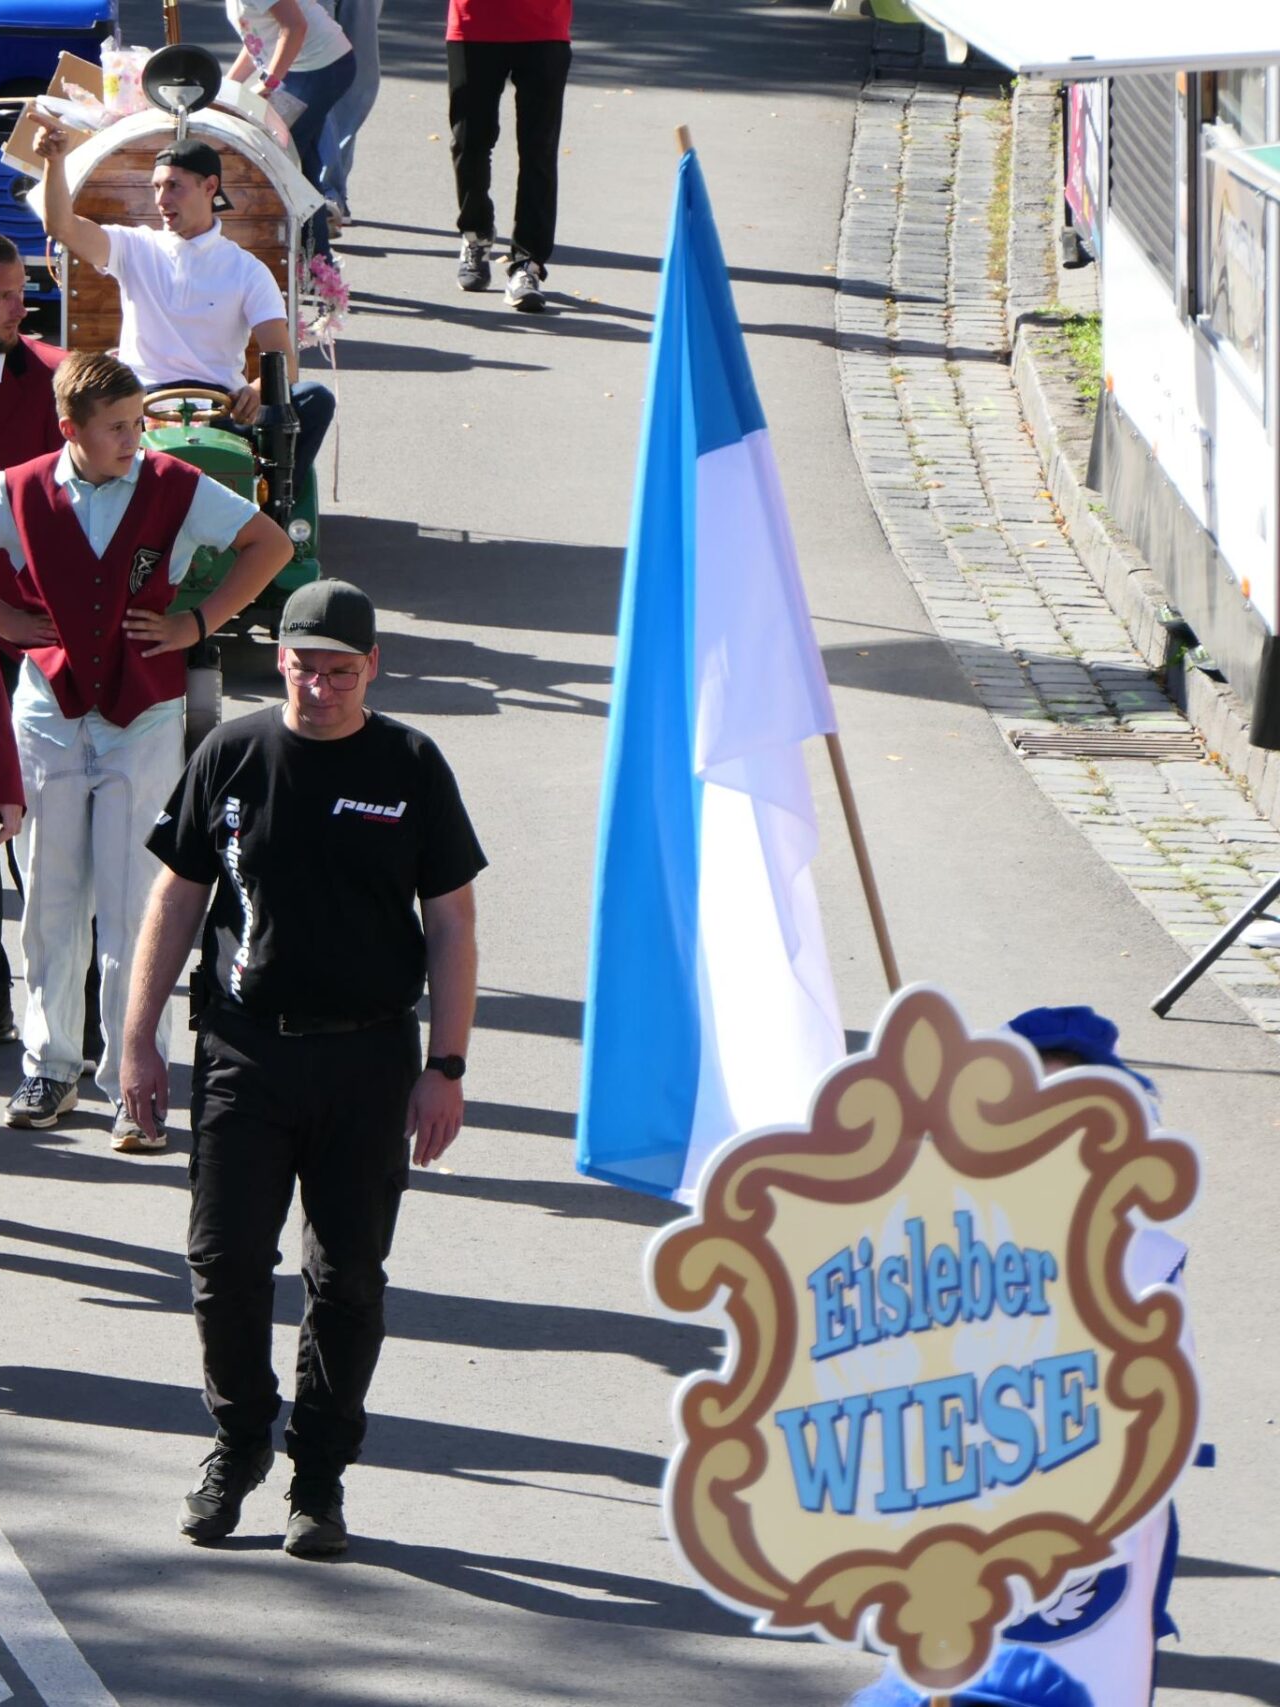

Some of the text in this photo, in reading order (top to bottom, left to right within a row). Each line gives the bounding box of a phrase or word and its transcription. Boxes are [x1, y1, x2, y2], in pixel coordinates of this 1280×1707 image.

[333, 797, 407, 818] pwd
[806, 1209, 1058, 1362] Eisleber
[775, 1348, 1101, 1516] WIESE
